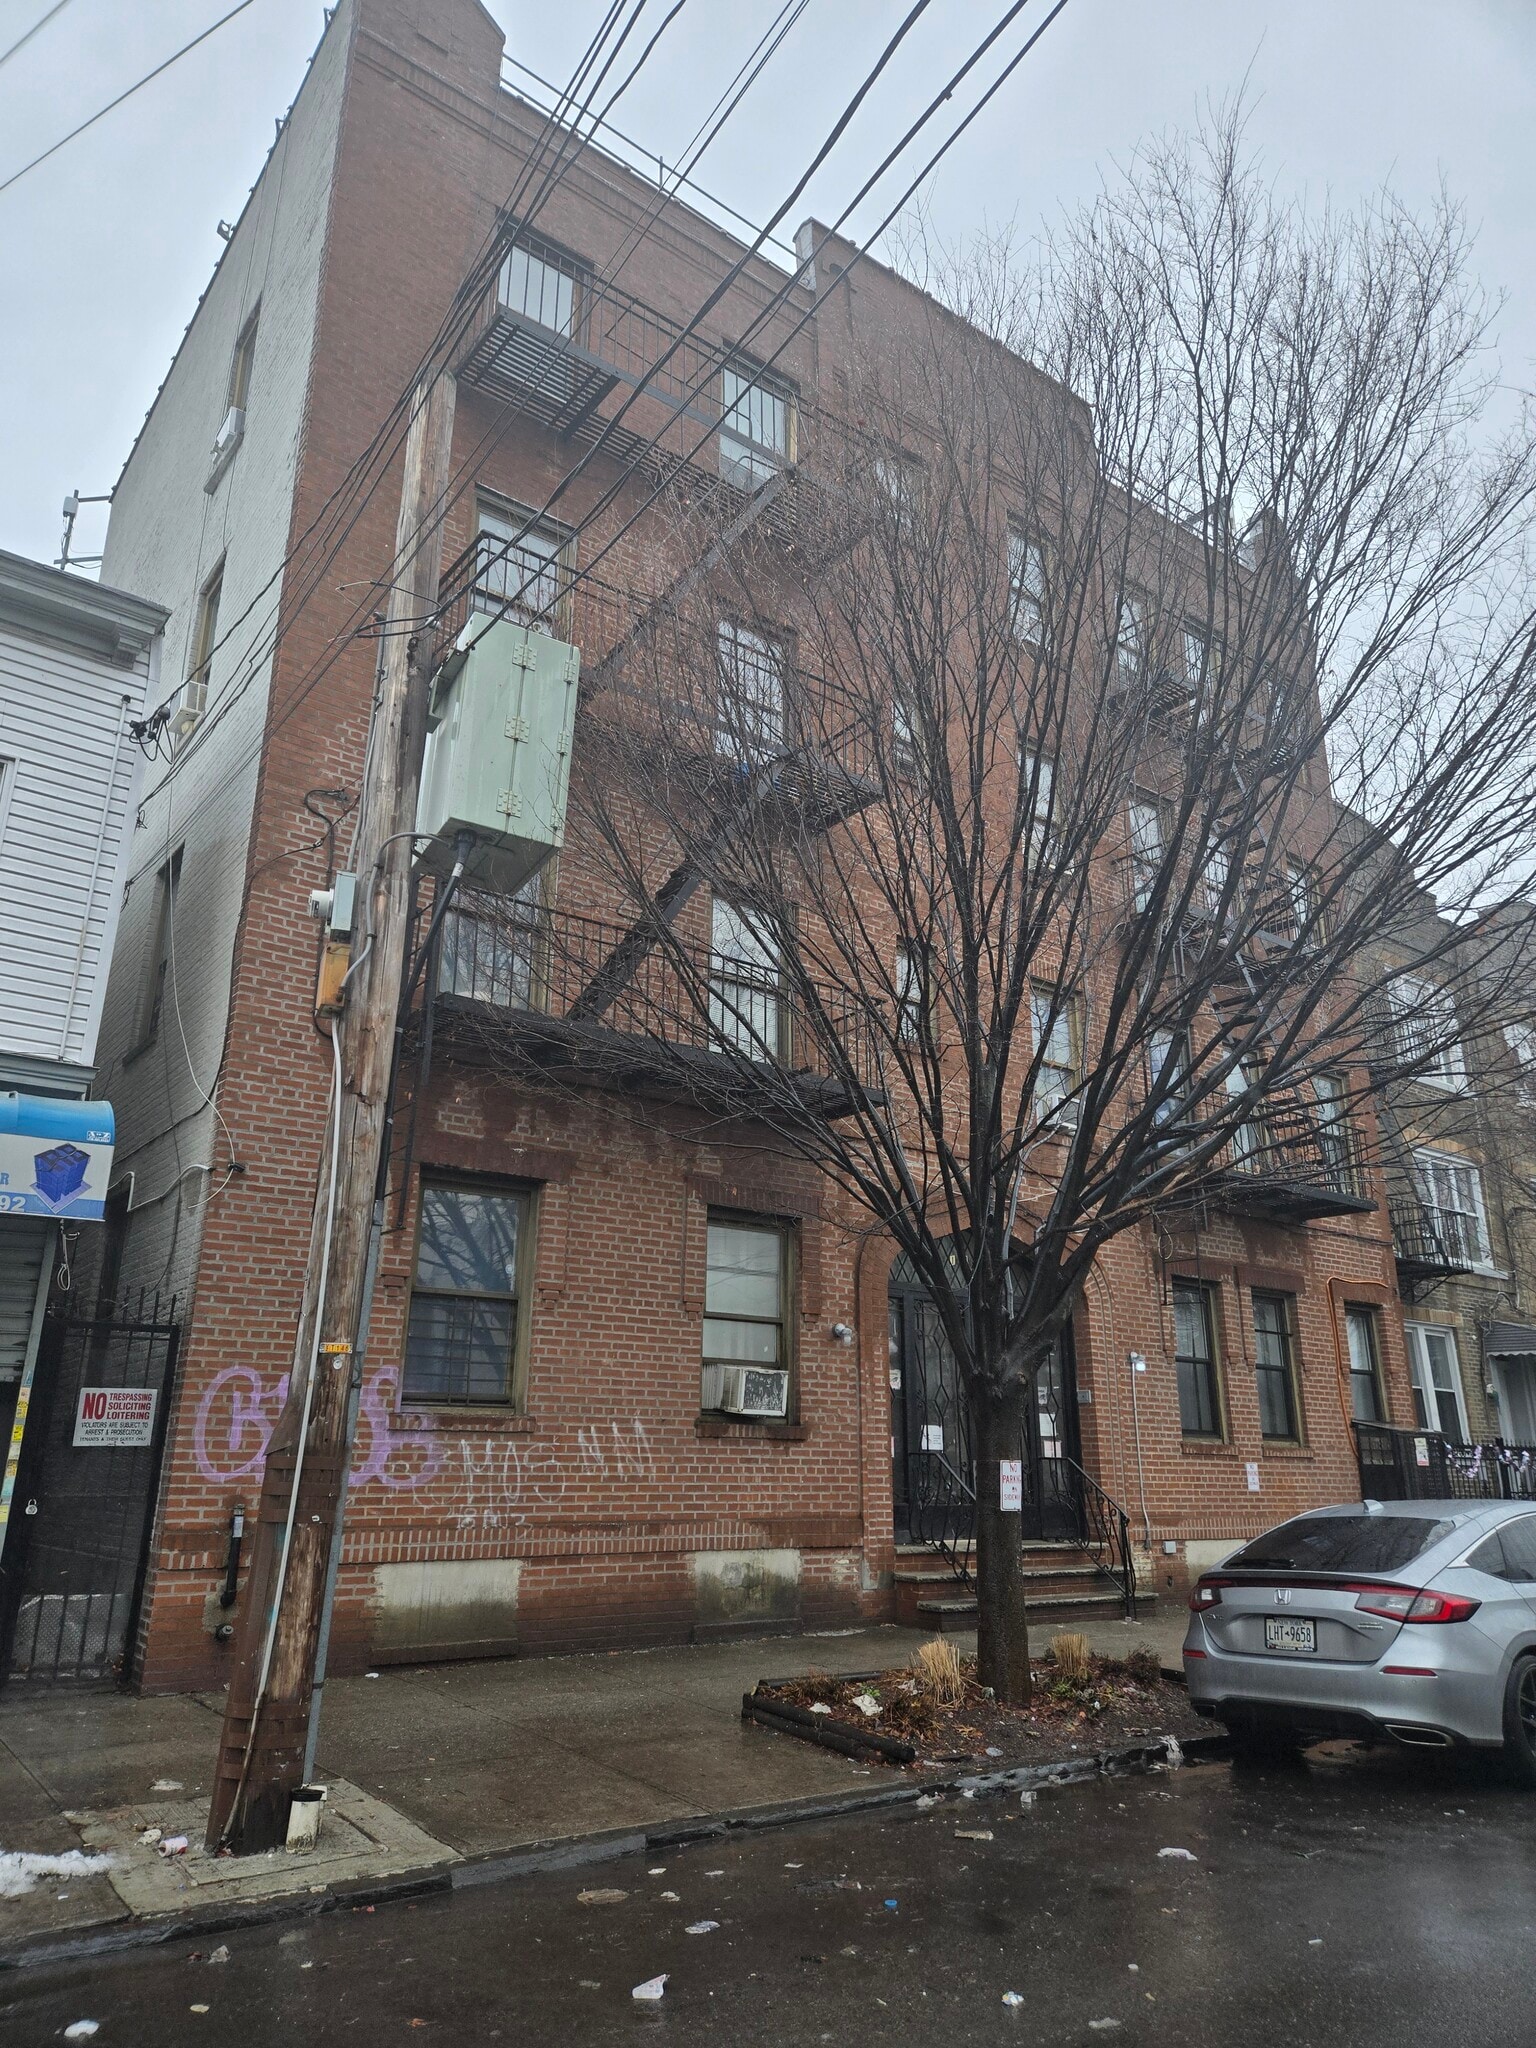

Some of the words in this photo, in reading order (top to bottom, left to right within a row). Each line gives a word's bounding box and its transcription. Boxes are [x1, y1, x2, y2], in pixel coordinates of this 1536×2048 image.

[0, 1194, 26, 1212] 92
[109, 1392, 153, 1401] TRESPASSING
[82, 1392, 108, 1420] NO
[107, 1402, 151, 1410] SOLICITING
[106, 1411, 150, 1420] LOITERING
[1010, 1464, 1017, 1473] NO
[1002, 1475, 1021, 1484] PARK
[1268, 1625, 1284, 1641] LHT
[1290, 1626, 1311, 1643] 9658
